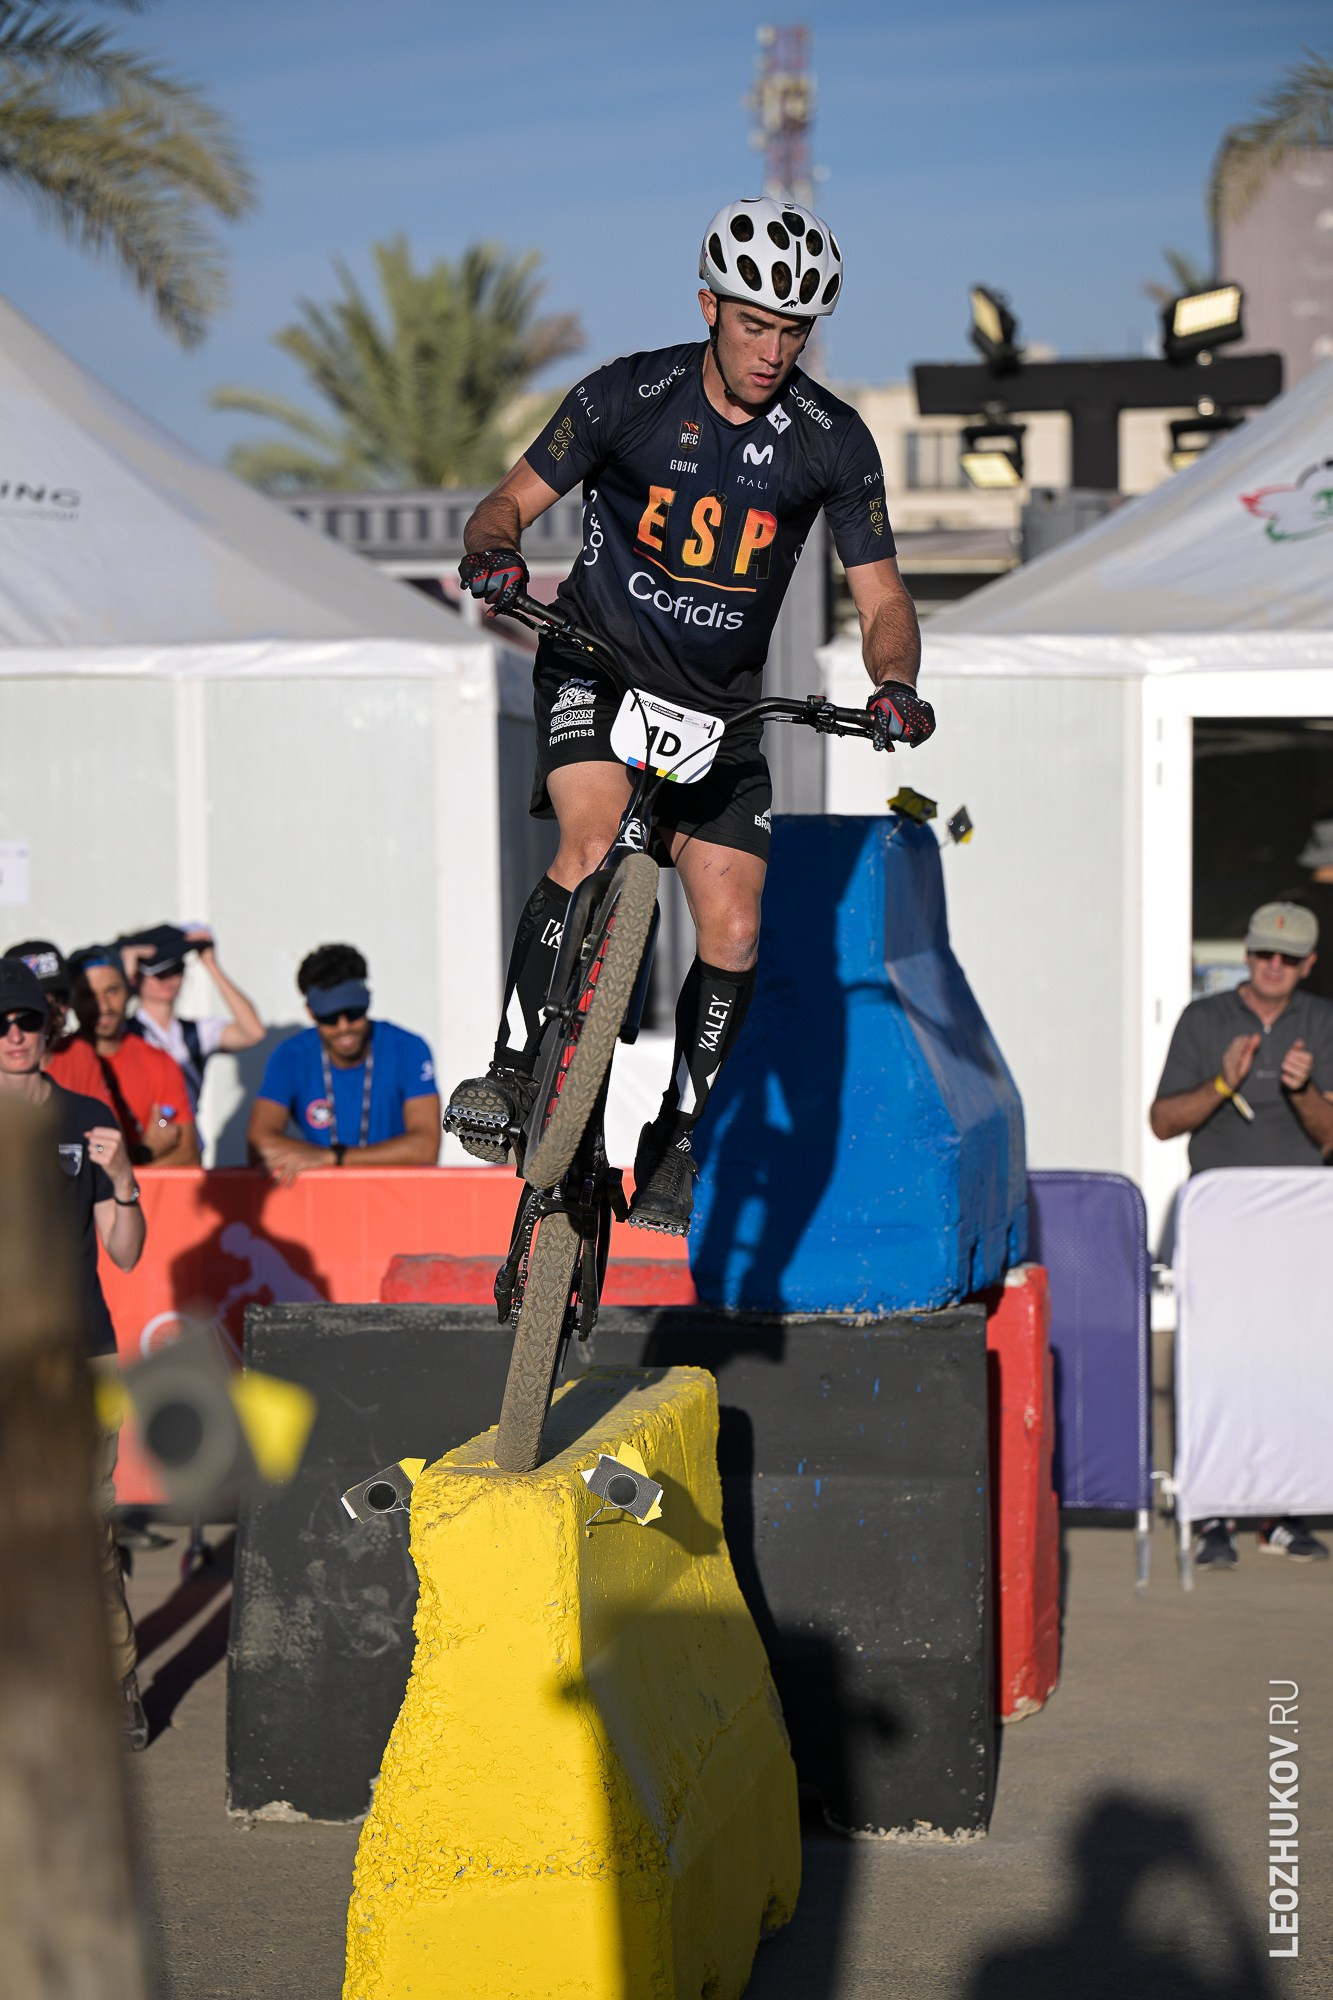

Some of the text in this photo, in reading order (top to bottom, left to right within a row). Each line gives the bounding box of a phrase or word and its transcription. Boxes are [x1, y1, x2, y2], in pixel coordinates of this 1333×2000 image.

[575, 386, 600, 424] RALI
[789, 385, 833, 430] Cofidis
[547, 416, 575, 461] ESP
[680, 432, 699, 445] RFEC
[669, 459, 699, 474] GOBIK
[736, 475, 768, 490] RALI
[637, 485, 777, 577] ESP
[628, 571, 744, 630] Cofidis
[548, 728, 595, 747] fammsa
[645, 725, 682, 757] 1D
